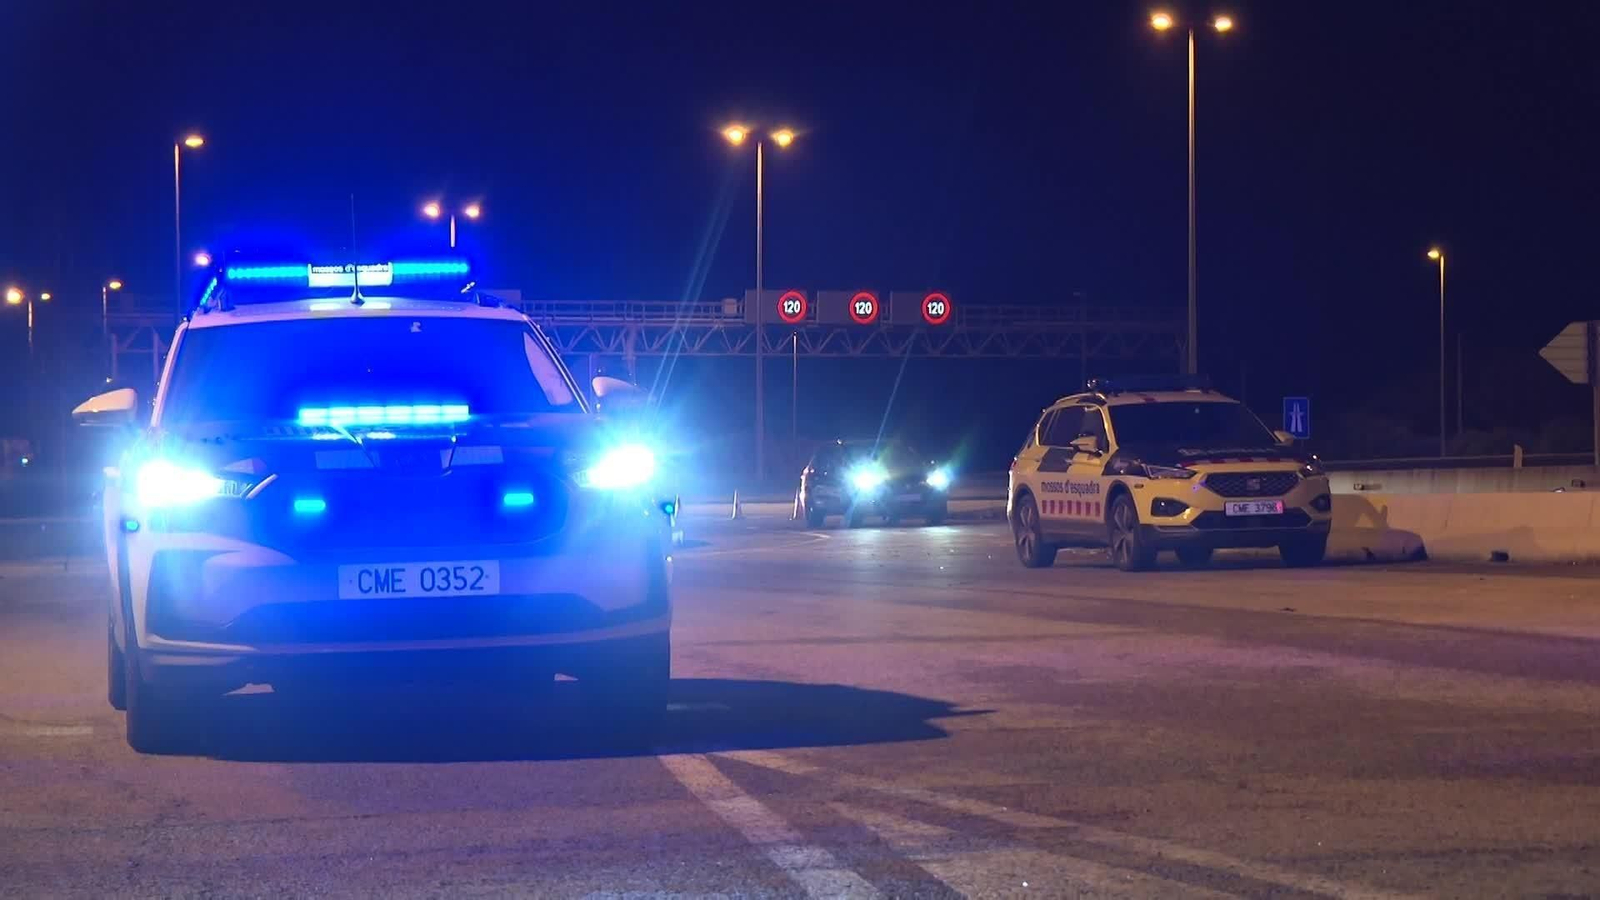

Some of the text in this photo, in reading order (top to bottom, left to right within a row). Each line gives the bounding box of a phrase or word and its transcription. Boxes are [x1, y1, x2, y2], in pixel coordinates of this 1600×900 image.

[783, 300, 801, 314] 120
[854, 301, 873, 315] 120
[927, 301, 945, 315] 120
[1041, 479, 1100, 497] mossos d'esquadra
[358, 566, 484, 594] CME 0352
